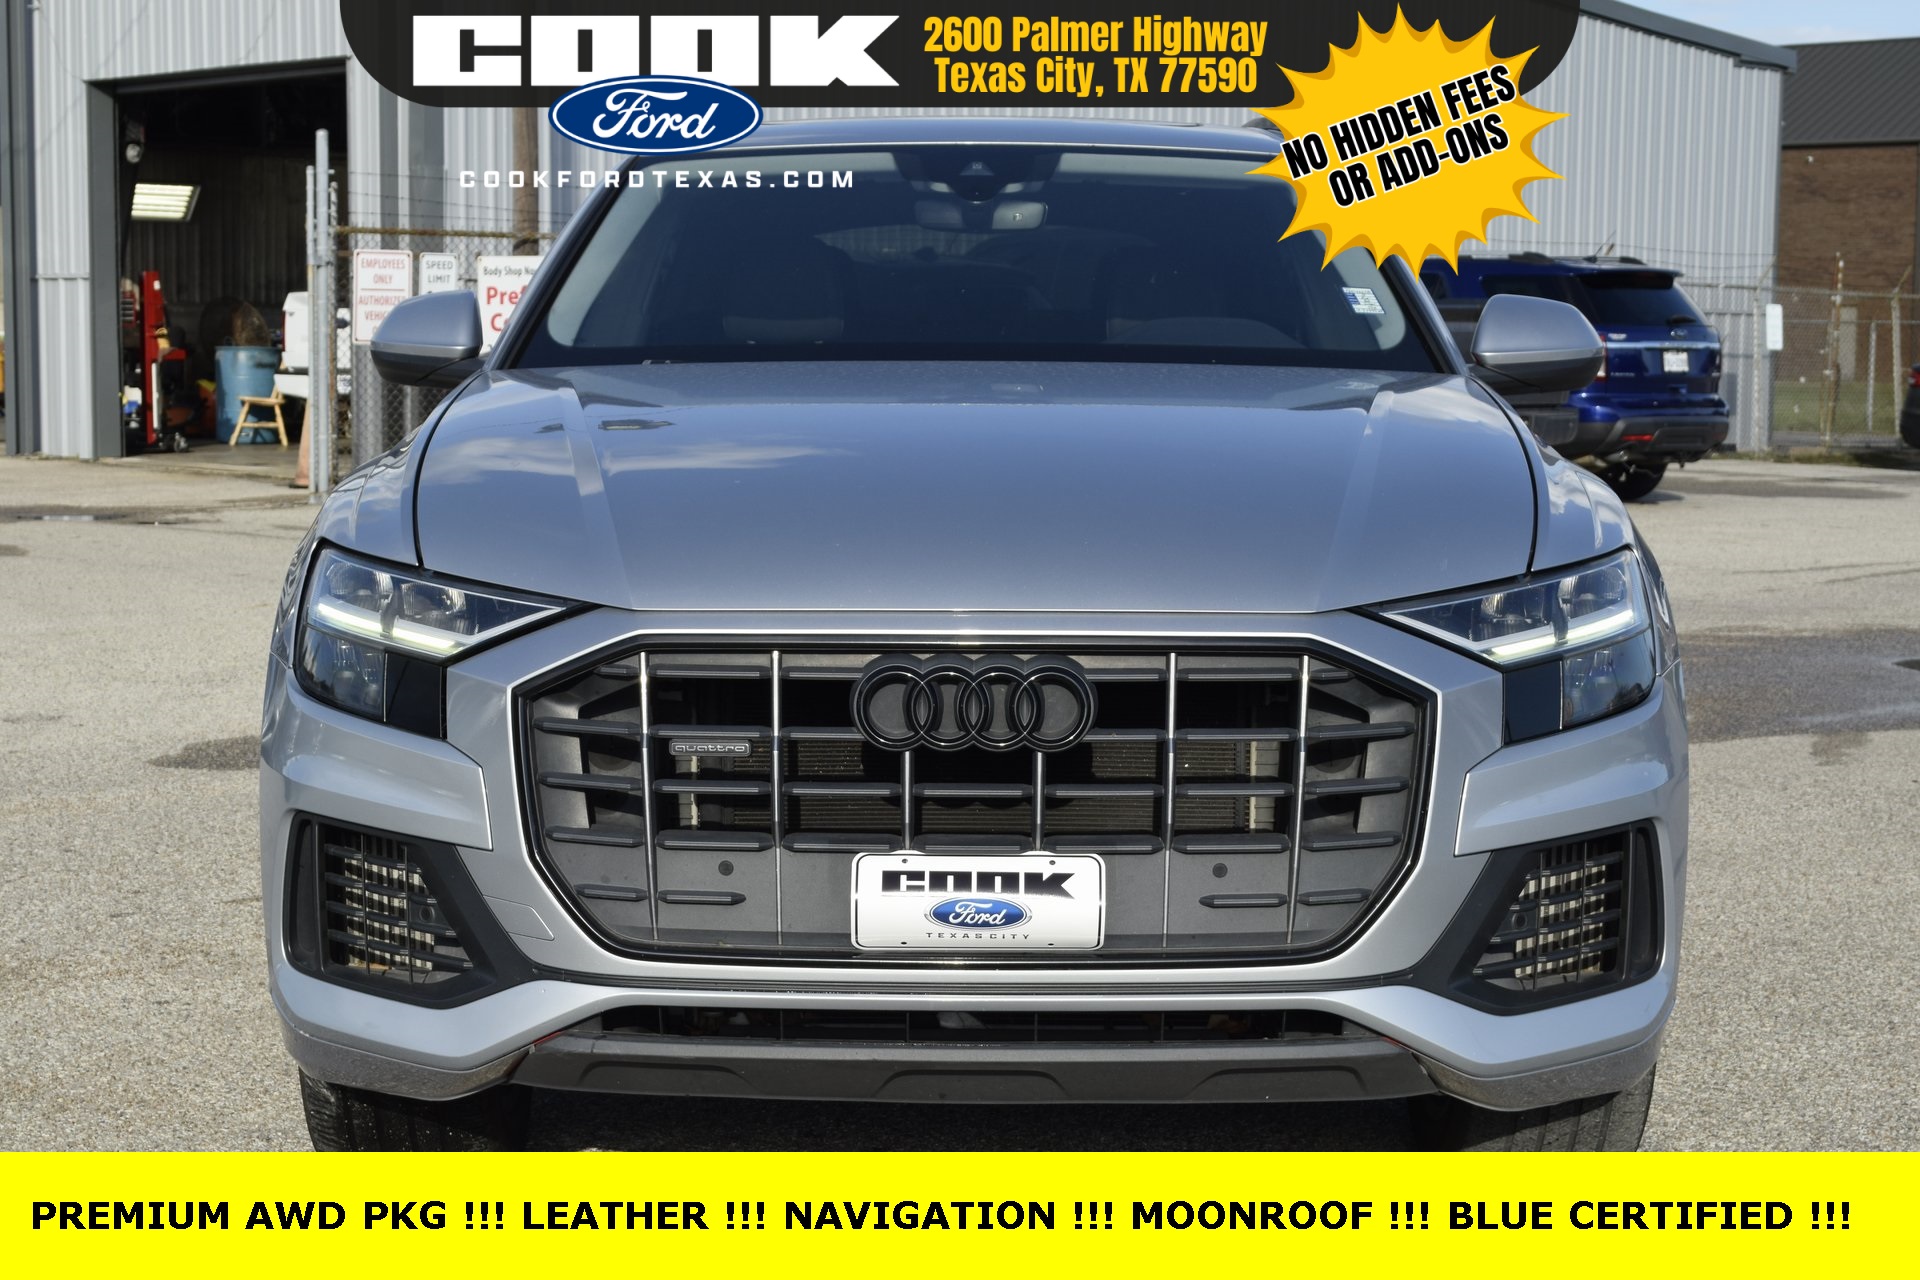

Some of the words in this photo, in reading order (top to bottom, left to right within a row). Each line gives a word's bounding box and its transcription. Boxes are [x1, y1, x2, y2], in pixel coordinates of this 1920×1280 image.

[360, 258, 406, 270] EMPLOYEES
[426, 260, 453, 270] SPEED
[483, 265, 502, 277] Body
[504, 265, 522, 277] Shop
[524, 266, 537, 275] No
[372, 273, 393, 284] ONLY
[428, 274, 450, 284] LIMIT
[486, 285, 528, 305] Pre
[675, 744, 746, 753] quattro
[881, 870, 1075, 899] COOK
[949, 901, 1007, 925] Ford
